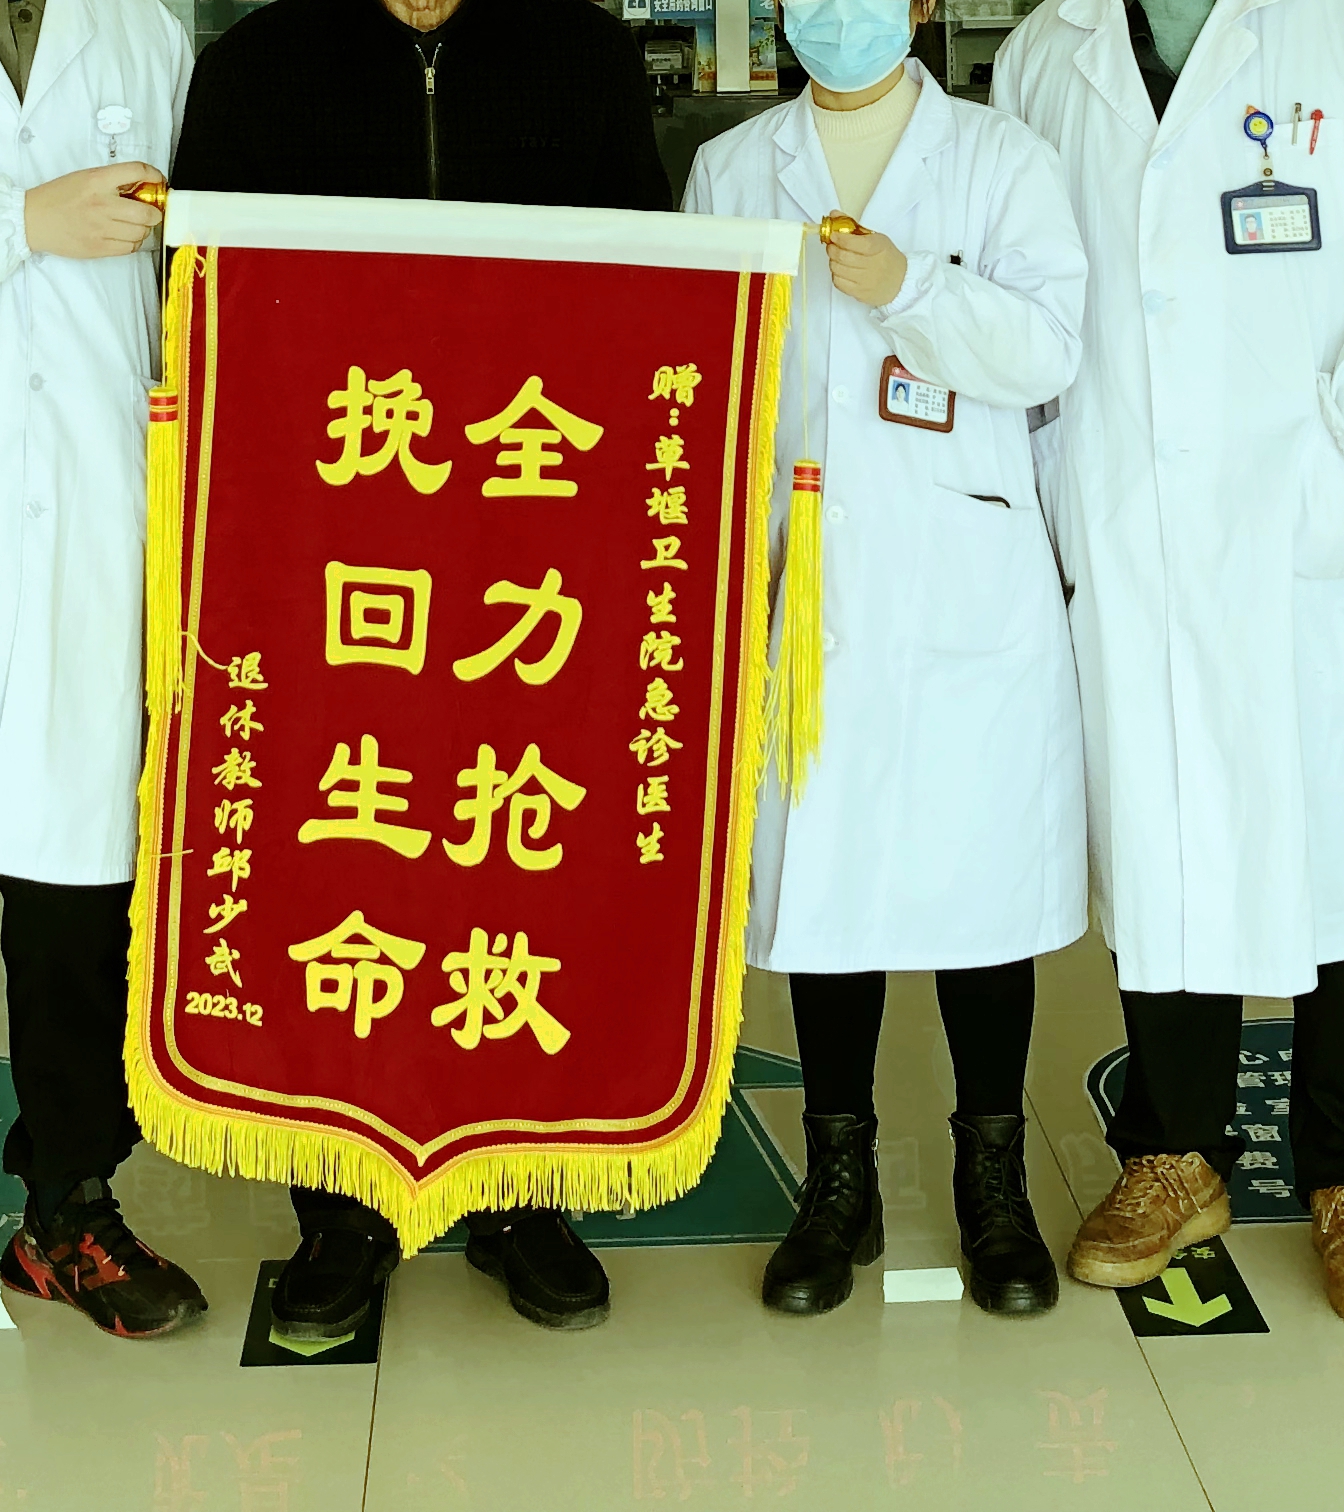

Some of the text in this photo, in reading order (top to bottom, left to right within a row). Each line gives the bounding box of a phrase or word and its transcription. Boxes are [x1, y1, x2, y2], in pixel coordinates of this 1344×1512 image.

[202, 652, 269, 988] 退休教师邱少武
[288, 366, 452, 1041] 挽回生命
[430, 376, 603, 1054] 全力抢救
[185, 992, 262, 1026] 2023.12
